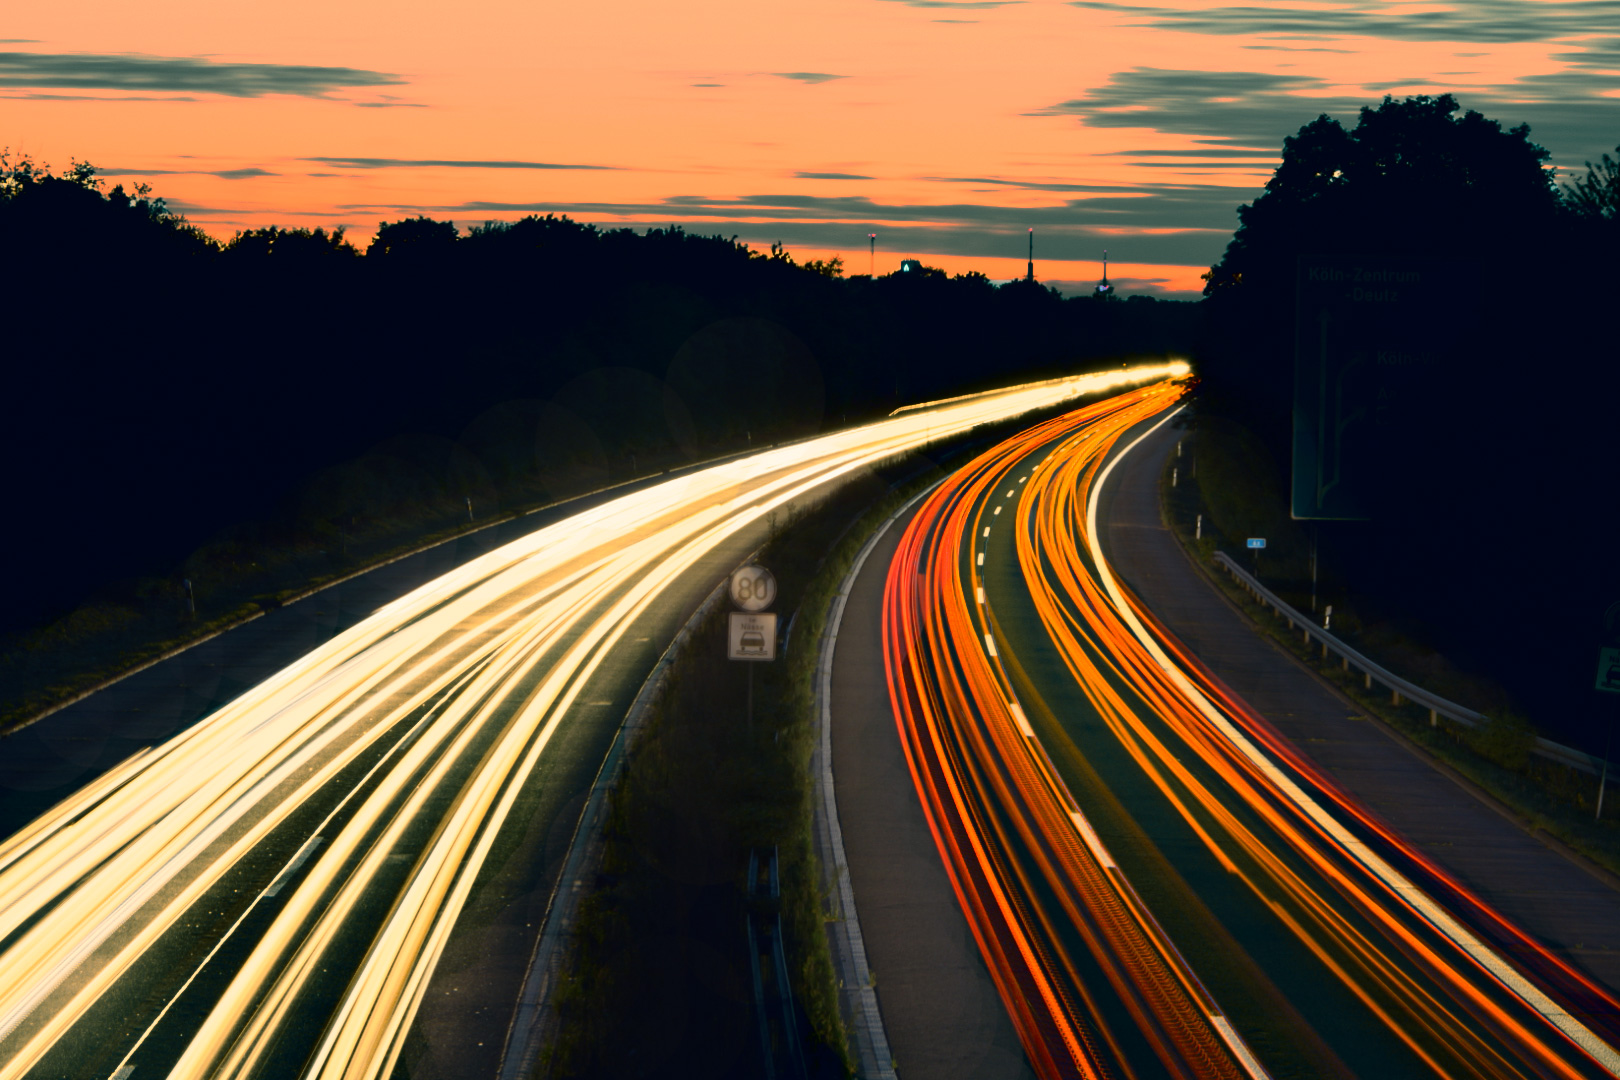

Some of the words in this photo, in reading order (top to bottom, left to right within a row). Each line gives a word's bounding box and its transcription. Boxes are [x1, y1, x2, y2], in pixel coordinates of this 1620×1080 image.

[1308, 265, 1421, 282] Köln-Zentrum
[1344, 286, 1399, 302] -Deutz
[738, 577, 768, 601] 80
